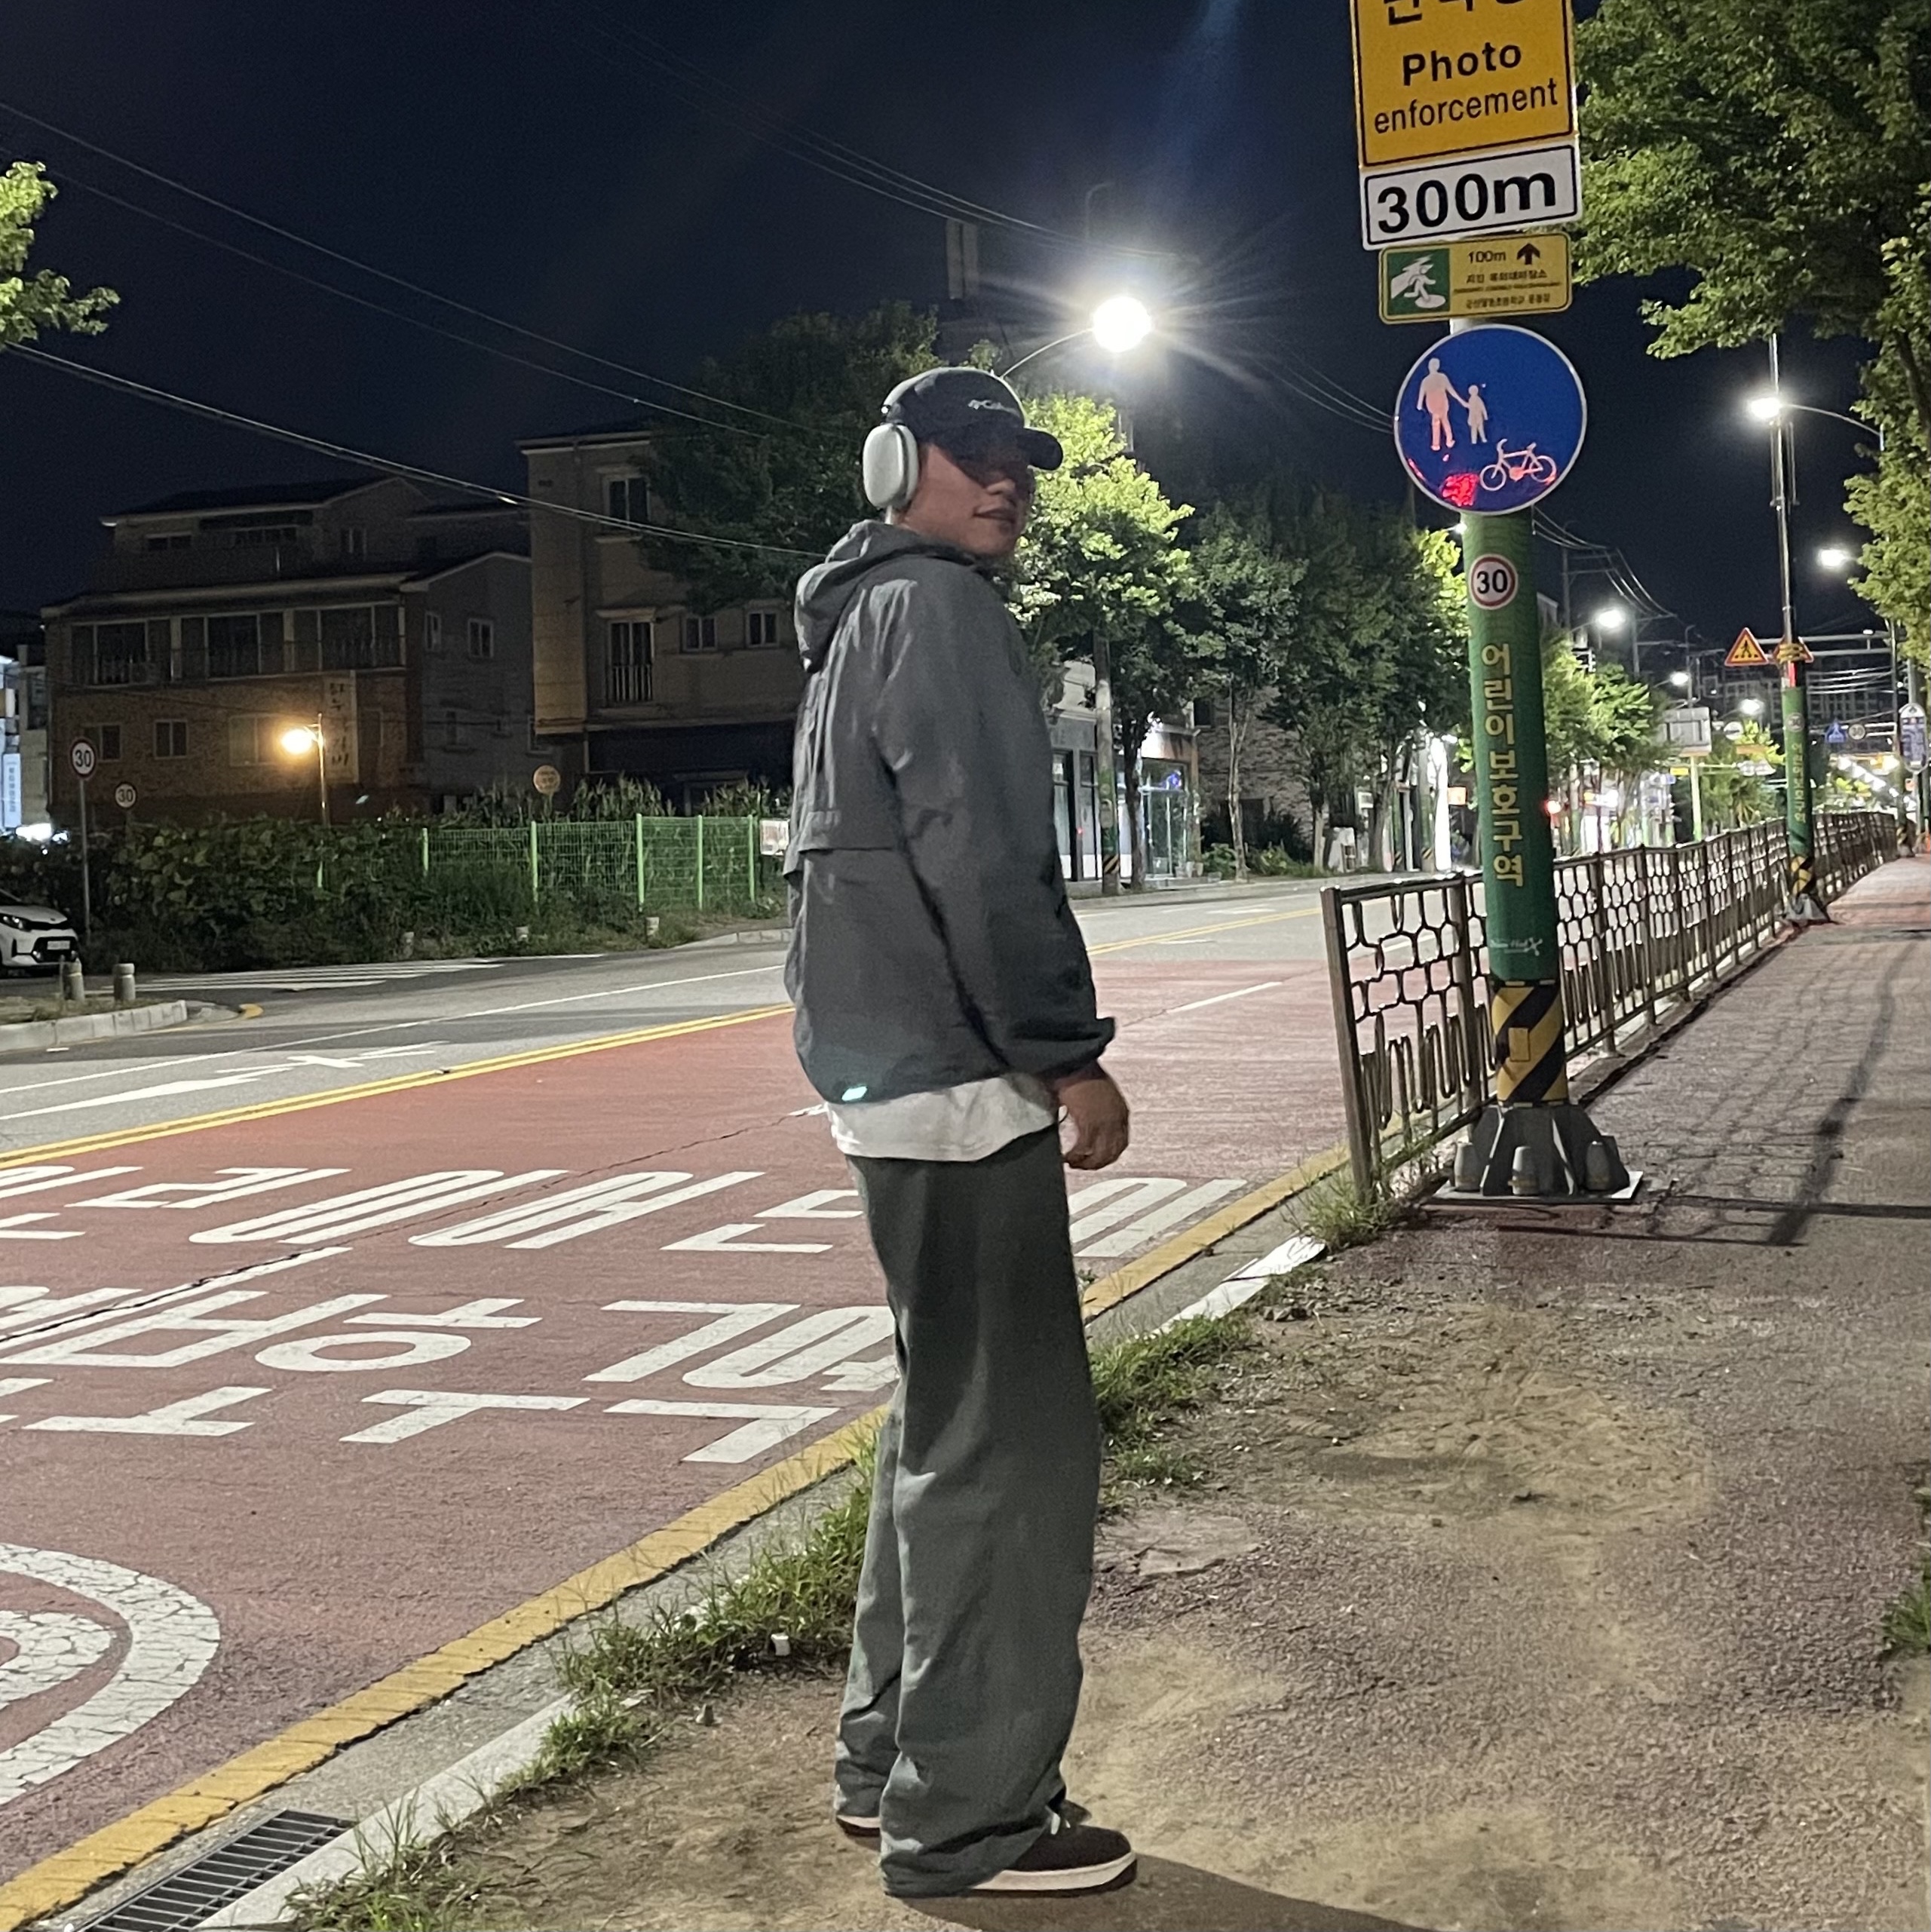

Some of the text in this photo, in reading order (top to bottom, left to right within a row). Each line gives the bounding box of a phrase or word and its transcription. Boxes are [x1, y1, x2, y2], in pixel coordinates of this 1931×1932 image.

[1402, 42, 1522, 86] Photo
[1375, 78, 1559, 133] enforcement
[1377, 172, 1556, 234] 300m
[1468, 250, 1506, 264] 100m
[1476, 569, 1508, 594] 30
[75, 749, 92, 768] 30
[118, 789, 133, 802] 30
